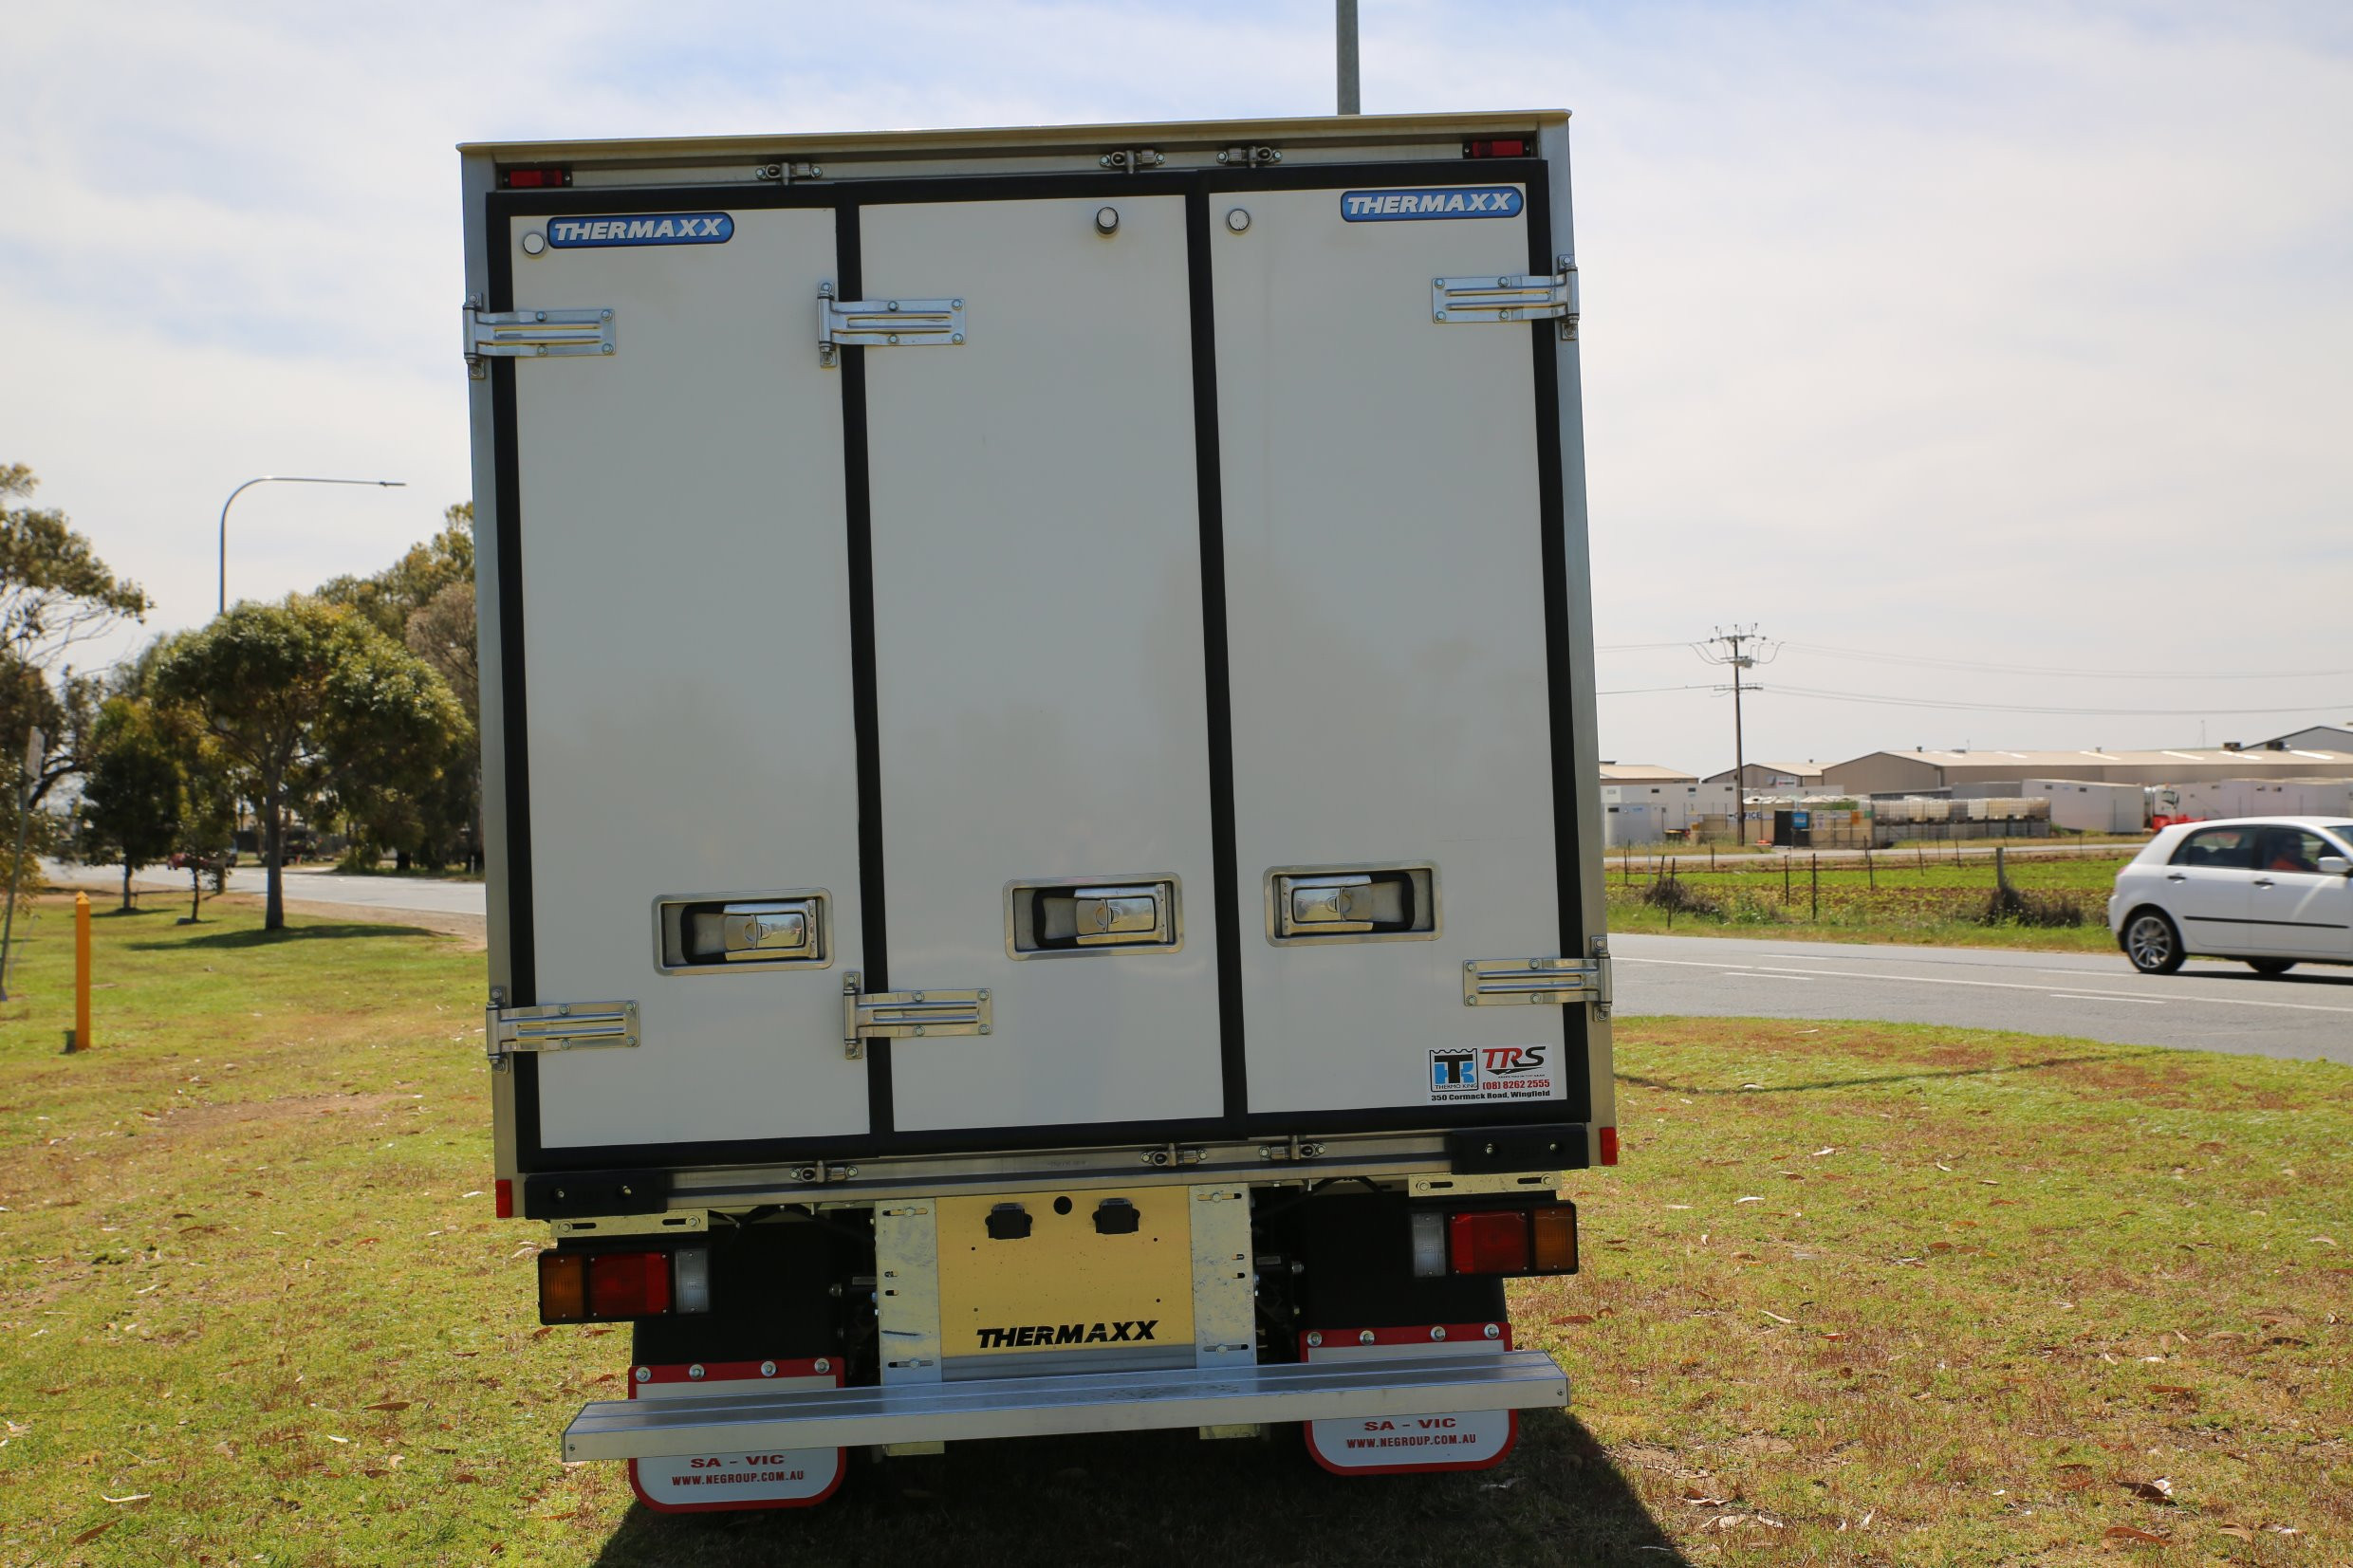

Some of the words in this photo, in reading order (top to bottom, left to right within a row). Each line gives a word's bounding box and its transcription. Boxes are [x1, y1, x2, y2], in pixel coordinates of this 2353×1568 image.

[1347, 193, 1513, 215] THERMAXX
[554, 218, 724, 241] THERMAXX
[1481, 1045, 1547, 1069] TRS
[1483, 1081, 1501, 1091] (08)
[1503, 1079, 1526, 1089] 8262
[1528, 1079, 1550, 1088] 2555
[1449, 1093, 1486, 1101] Cormack
[1487, 1091, 1510, 1099] Road,
[1510, 1090, 1550, 1098] Wingfield
[976, 1319, 1159, 1349] THERMAXX
[1364, 1420, 1396, 1431] SA
[1417, 1417, 1456, 1430] VIC
[1346, 1433, 1476, 1448] WWW.NEGROUP.COM.AU
[690, 1457, 722, 1468] SA
[745, 1454, 785, 1466] VIC
[672, 1470, 805, 1485] WWW.NEGROUP.COM.AU
